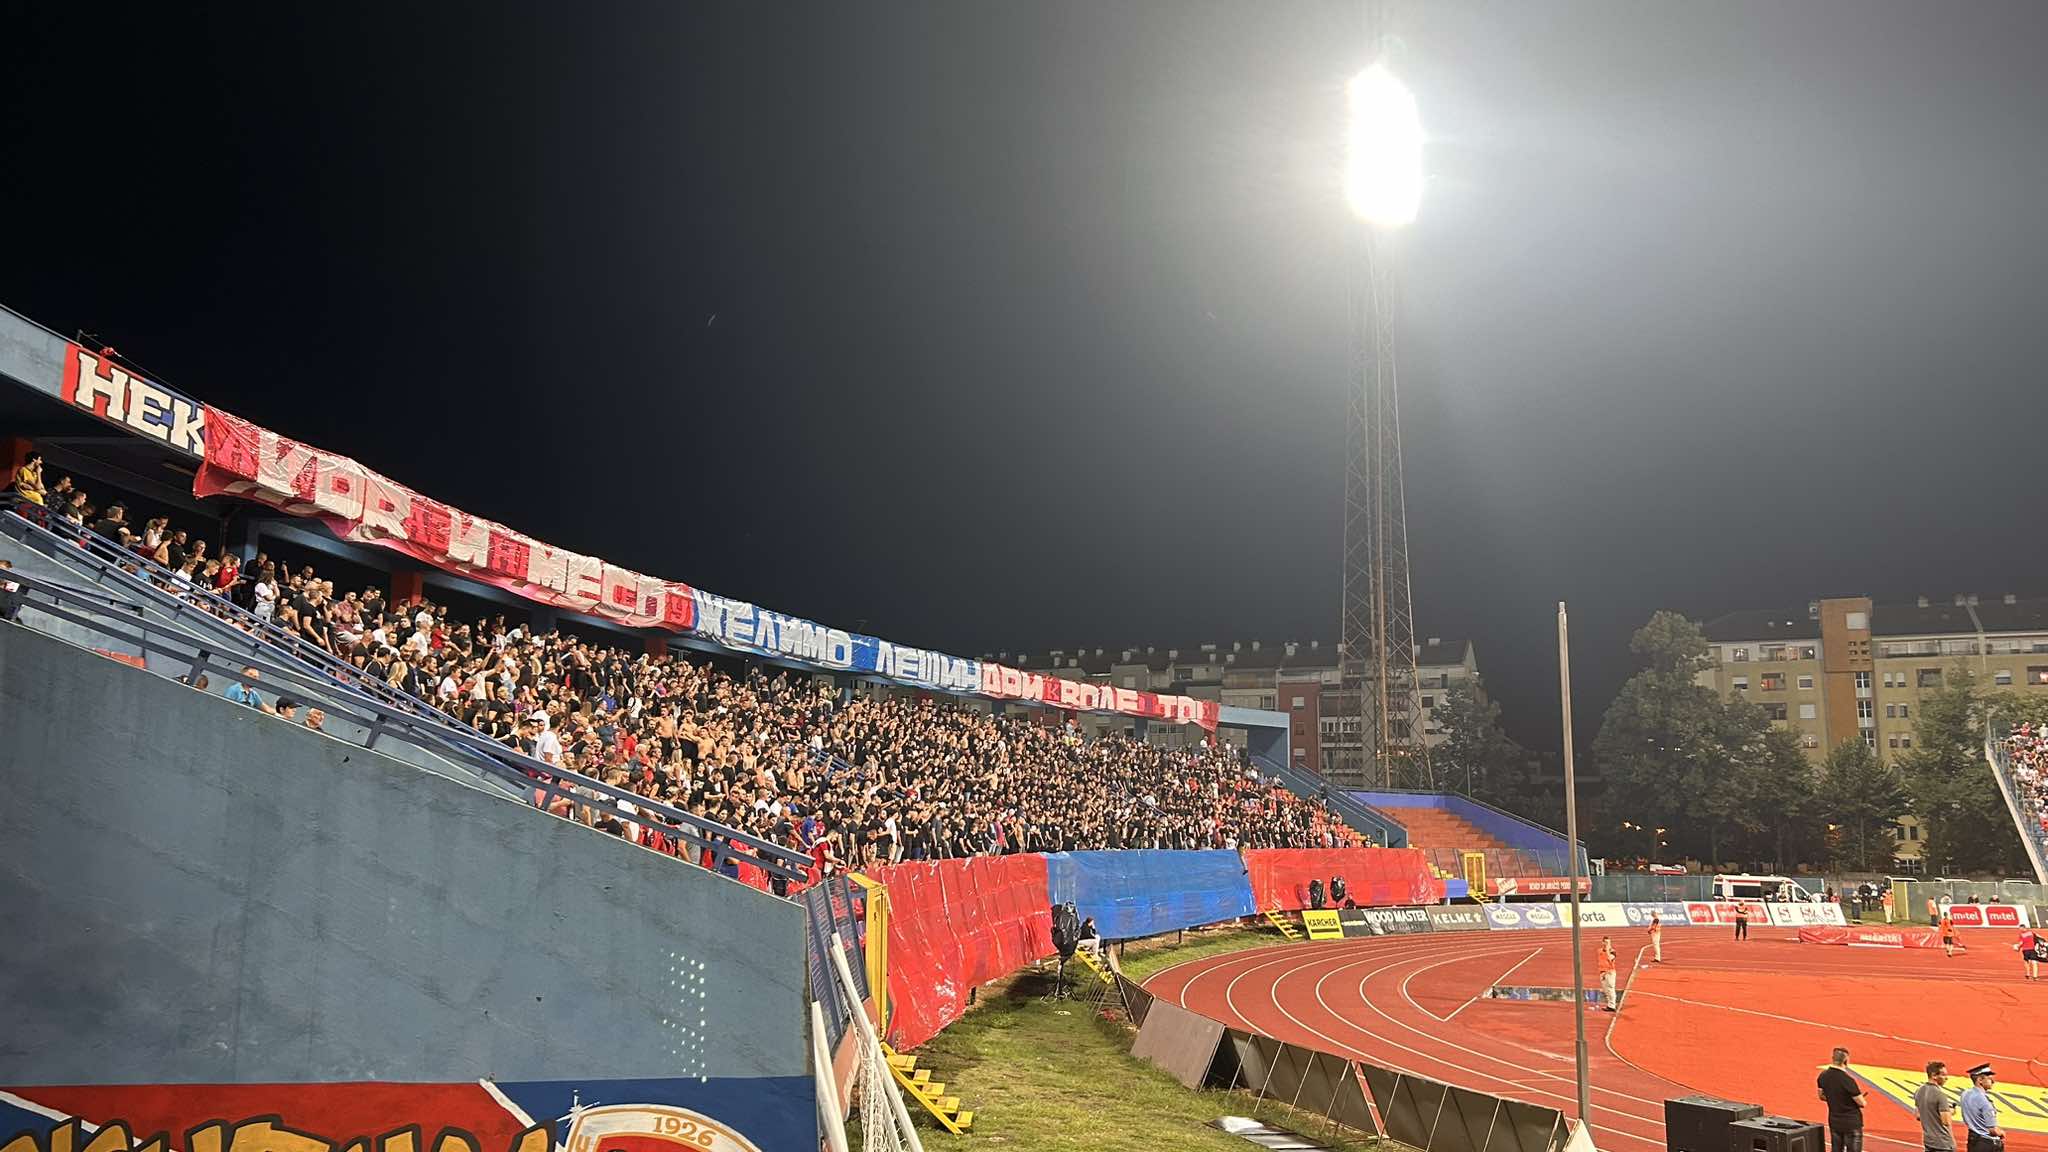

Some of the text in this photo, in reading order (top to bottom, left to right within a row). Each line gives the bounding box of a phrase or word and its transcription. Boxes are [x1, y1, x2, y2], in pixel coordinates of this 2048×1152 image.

[693, 588, 852, 663] ЖЕЛИМО
[1363, 909, 1429, 924] WOOD MASTER
[1432, 912, 1472, 925] KELME
[1577, 911, 1606, 922] orta
[653, 1116, 717, 1147] 1926
